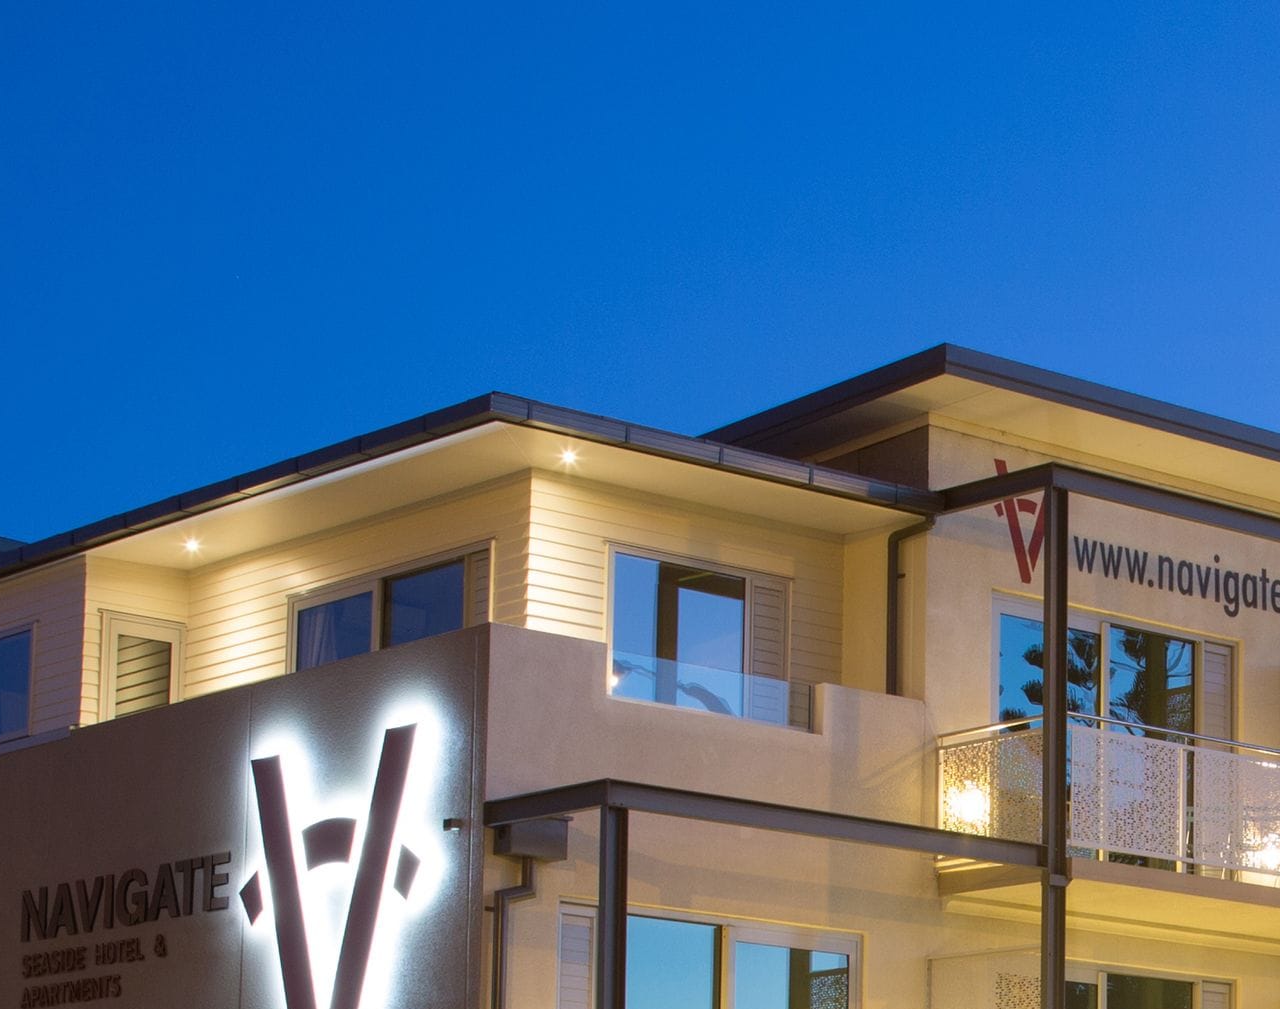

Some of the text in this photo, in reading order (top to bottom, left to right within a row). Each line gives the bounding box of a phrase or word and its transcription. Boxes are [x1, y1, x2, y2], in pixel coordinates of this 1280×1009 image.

[21, 851, 231, 942] NAVIGATE
[22, 933, 168, 979] SEASIDE HOTEL &
